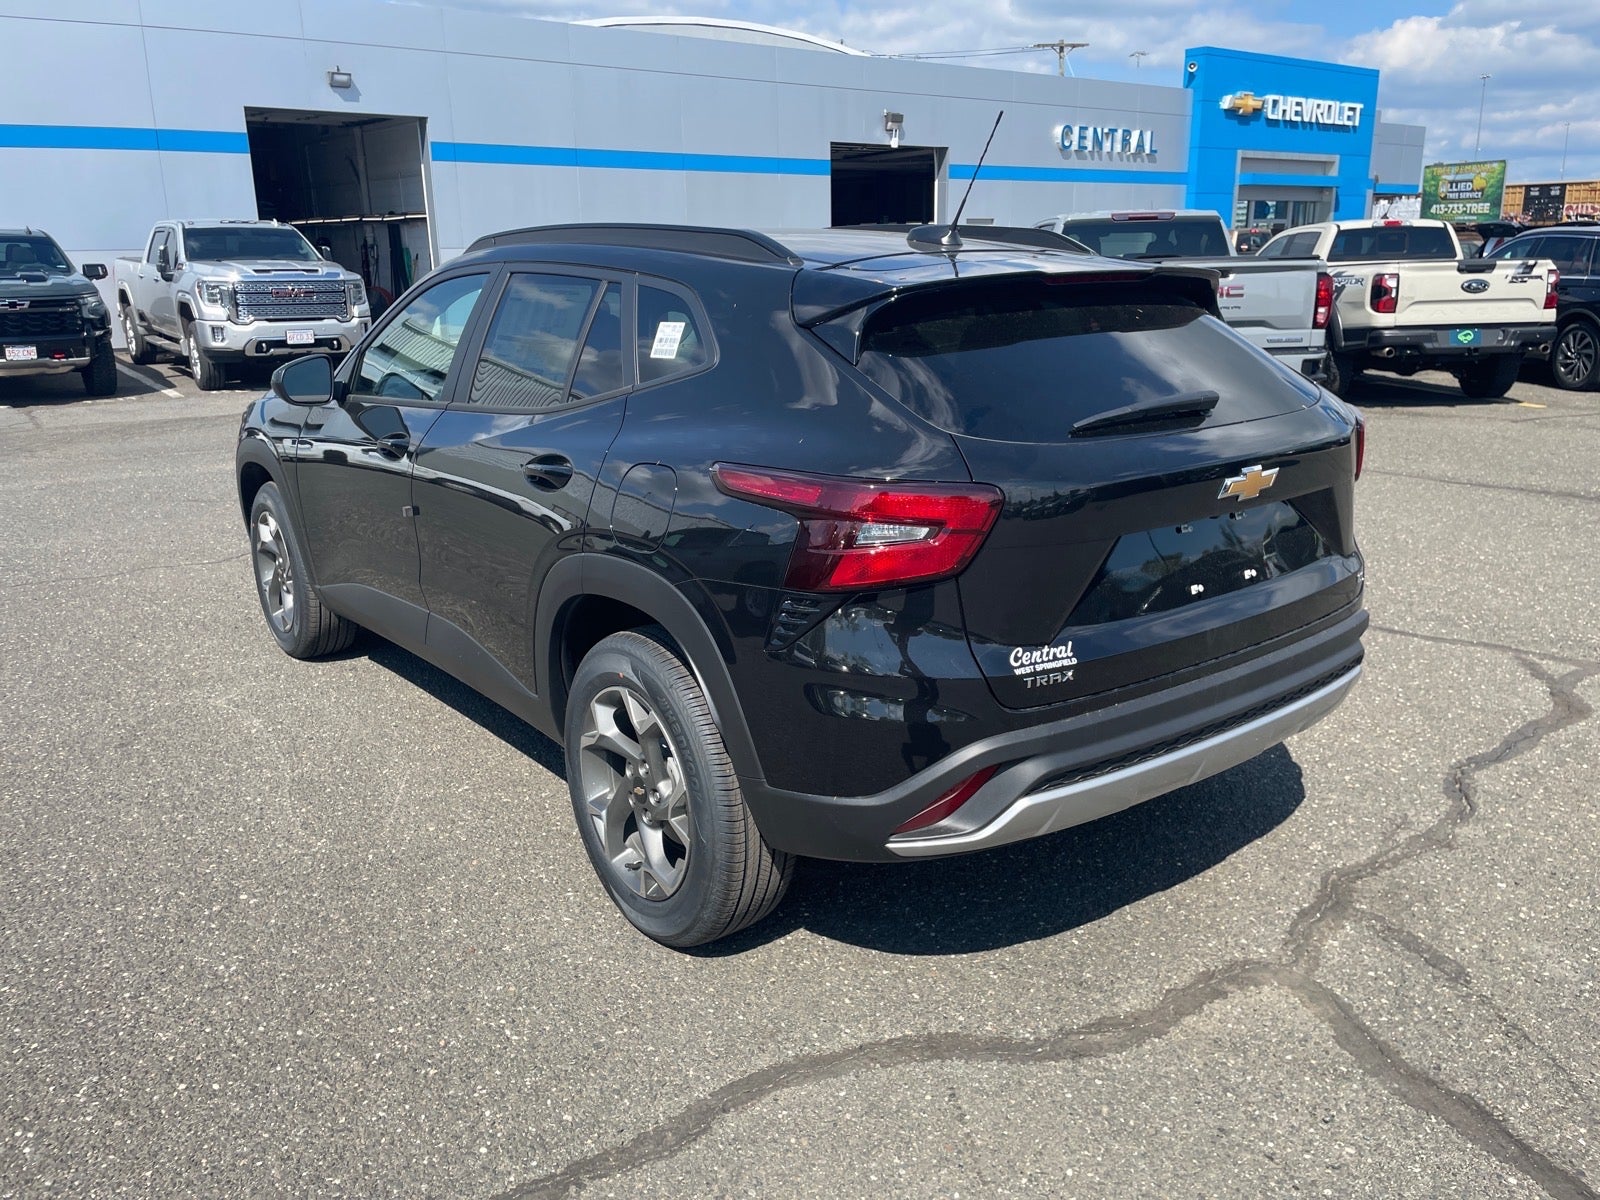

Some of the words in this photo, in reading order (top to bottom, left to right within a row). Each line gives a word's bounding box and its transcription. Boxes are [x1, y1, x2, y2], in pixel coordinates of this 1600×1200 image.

[1264, 94, 1364, 126] CHEVROLET
[1060, 124, 1158, 154] CENTRAL
[1460, 191, 1482, 199] SERVICE
[1009, 640, 1074, 667] Central
[1013, 665, 1035, 676] WEST
[1034, 657, 1078, 672] SPRINGFIELD
[1023, 669, 1074, 689] TRAX
